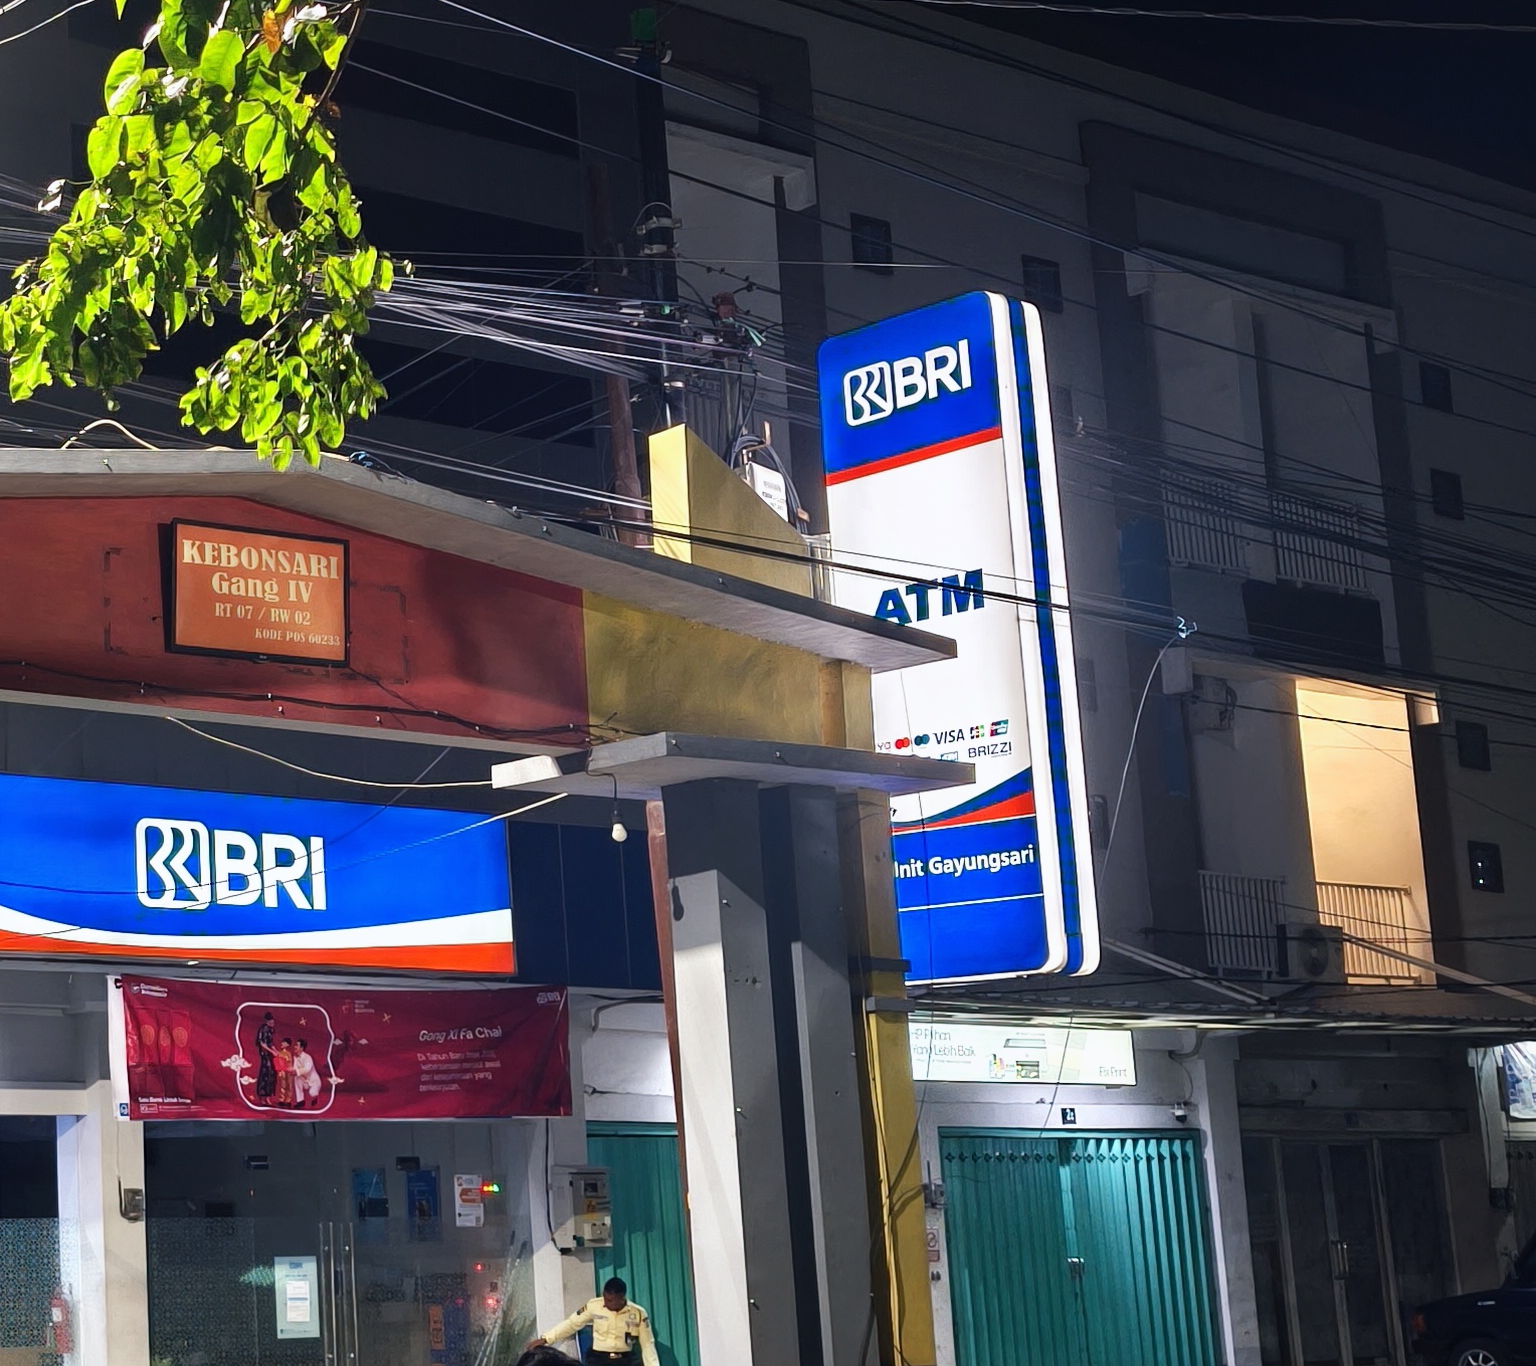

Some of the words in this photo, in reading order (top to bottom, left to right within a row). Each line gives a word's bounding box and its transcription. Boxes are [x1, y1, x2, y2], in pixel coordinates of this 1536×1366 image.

[893, 339, 972, 410] BRI
[181, 539, 340, 579] KEBONSARI
[211, 571, 279, 602] Gang
[287, 580, 314, 604] IV
[875, 568, 985, 626] ATM
[214, 602, 233, 618] RT
[236, 604, 253, 620] 07
[270, 607, 291, 624] RW
[294, 610, 311, 626] 02
[254, 628, 283, 641] KODE
[286, 631, 305, 643] POS
[932, 728, 965, 745] VISA
[968, 741, 1012, 758] BRIZZI
[214, 828, 326, 911] BRI
[928, 843, 1034, 878] Gayungsari
[419, 1029, 446, 1043] Gong
[460, 1028, 474, 1040] Fa
